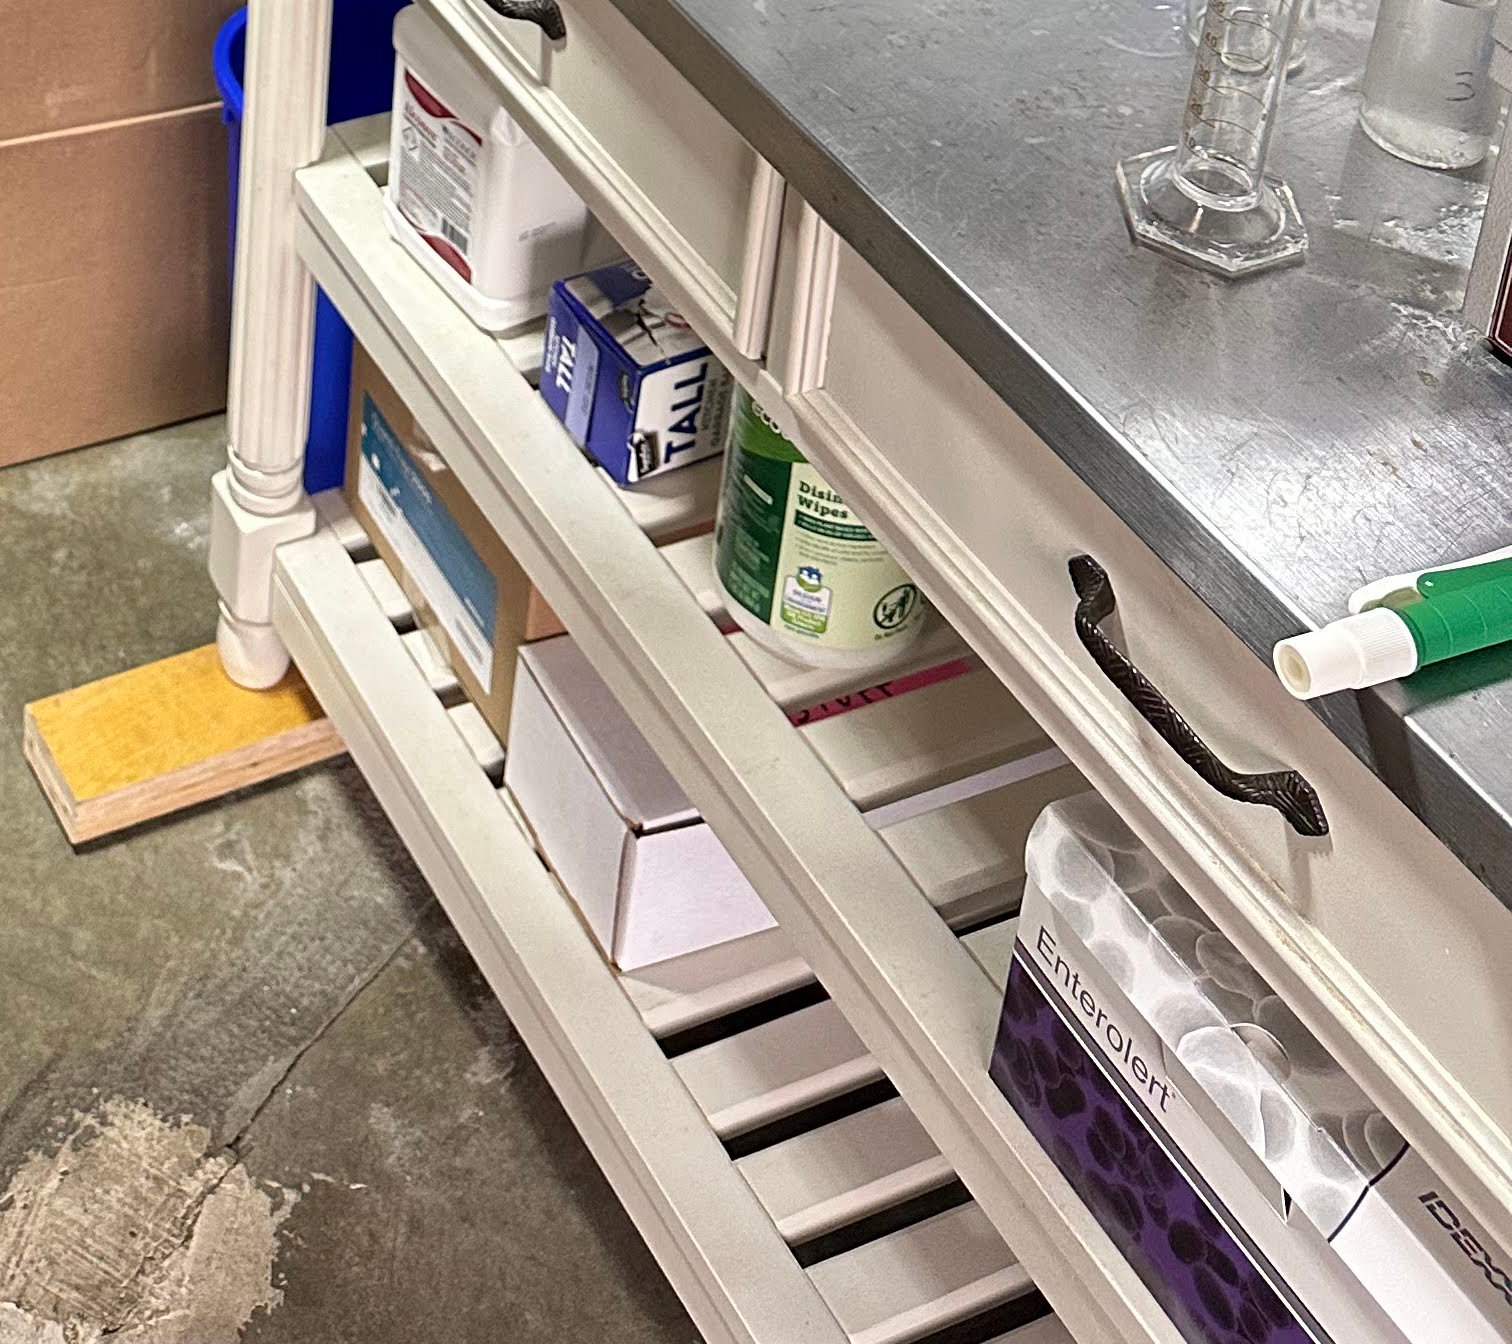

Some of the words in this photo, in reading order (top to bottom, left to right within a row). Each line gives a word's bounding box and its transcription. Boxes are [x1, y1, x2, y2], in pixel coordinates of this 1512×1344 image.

[555, 334, 577, 394] TALL
[664, 362, 709, 464] TALL
[797, 494, 848, 519] Wipes
[799, 480, 844, 504] Disin
[1037, 925, 1172, 1113] Enterolert
